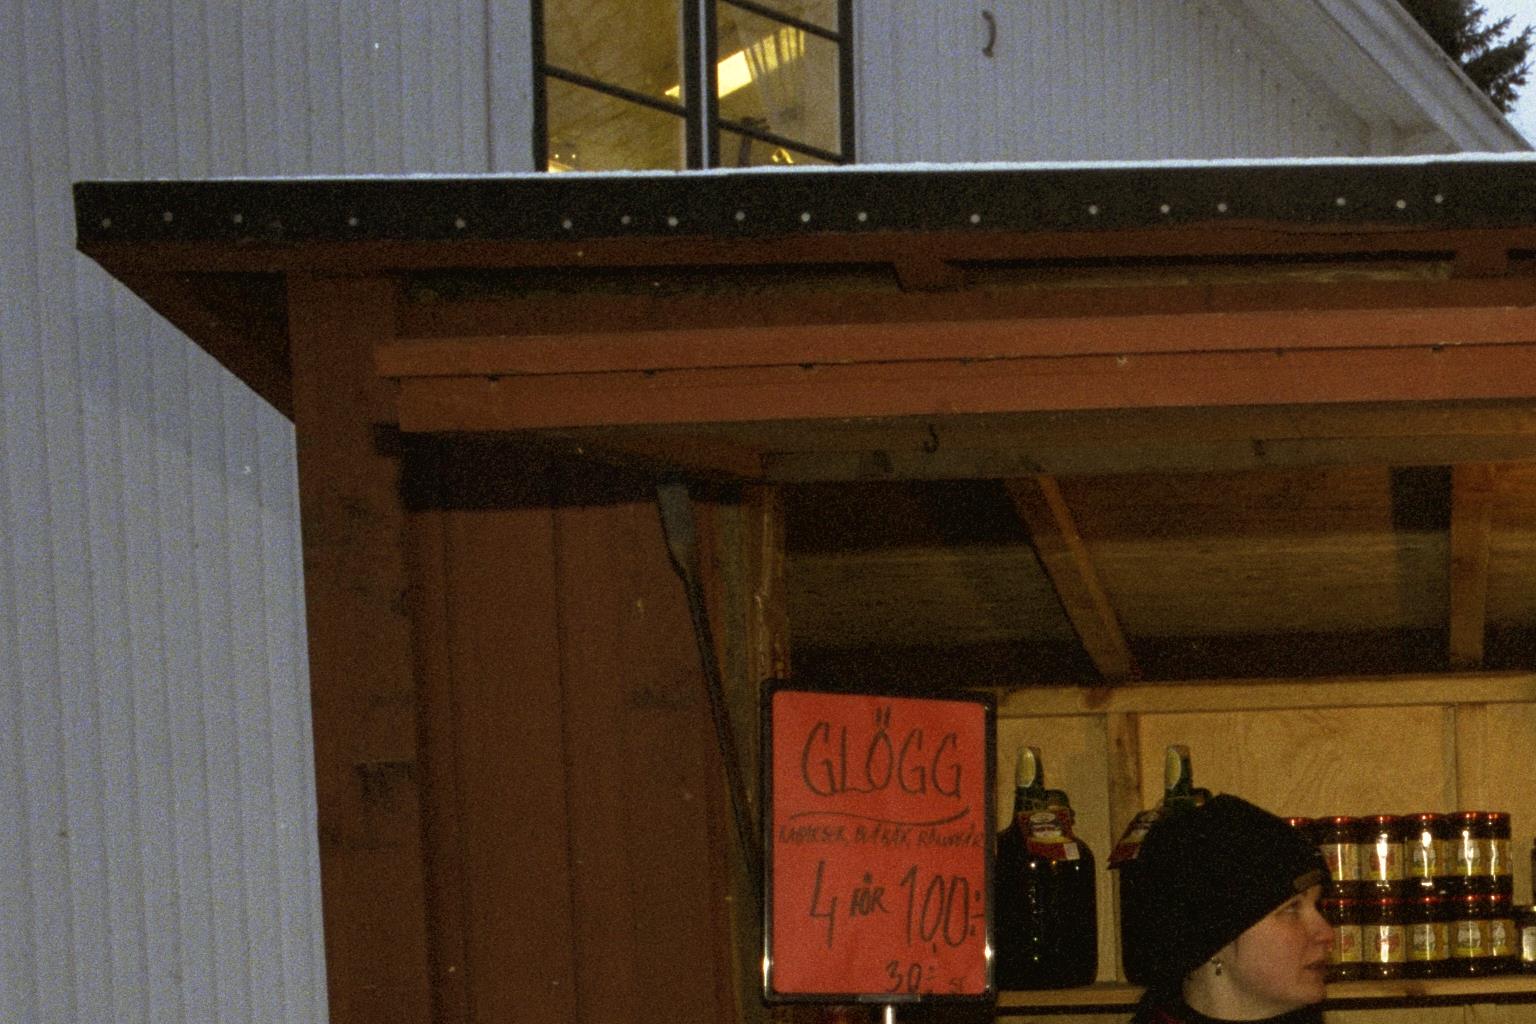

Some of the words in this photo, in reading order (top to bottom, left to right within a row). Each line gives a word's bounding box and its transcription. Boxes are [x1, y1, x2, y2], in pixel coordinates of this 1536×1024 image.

[800, 708, 963, 799] GLÖGG
[809, 860, 838, 949] 4
[848, 873, 891, 917] FÖR
